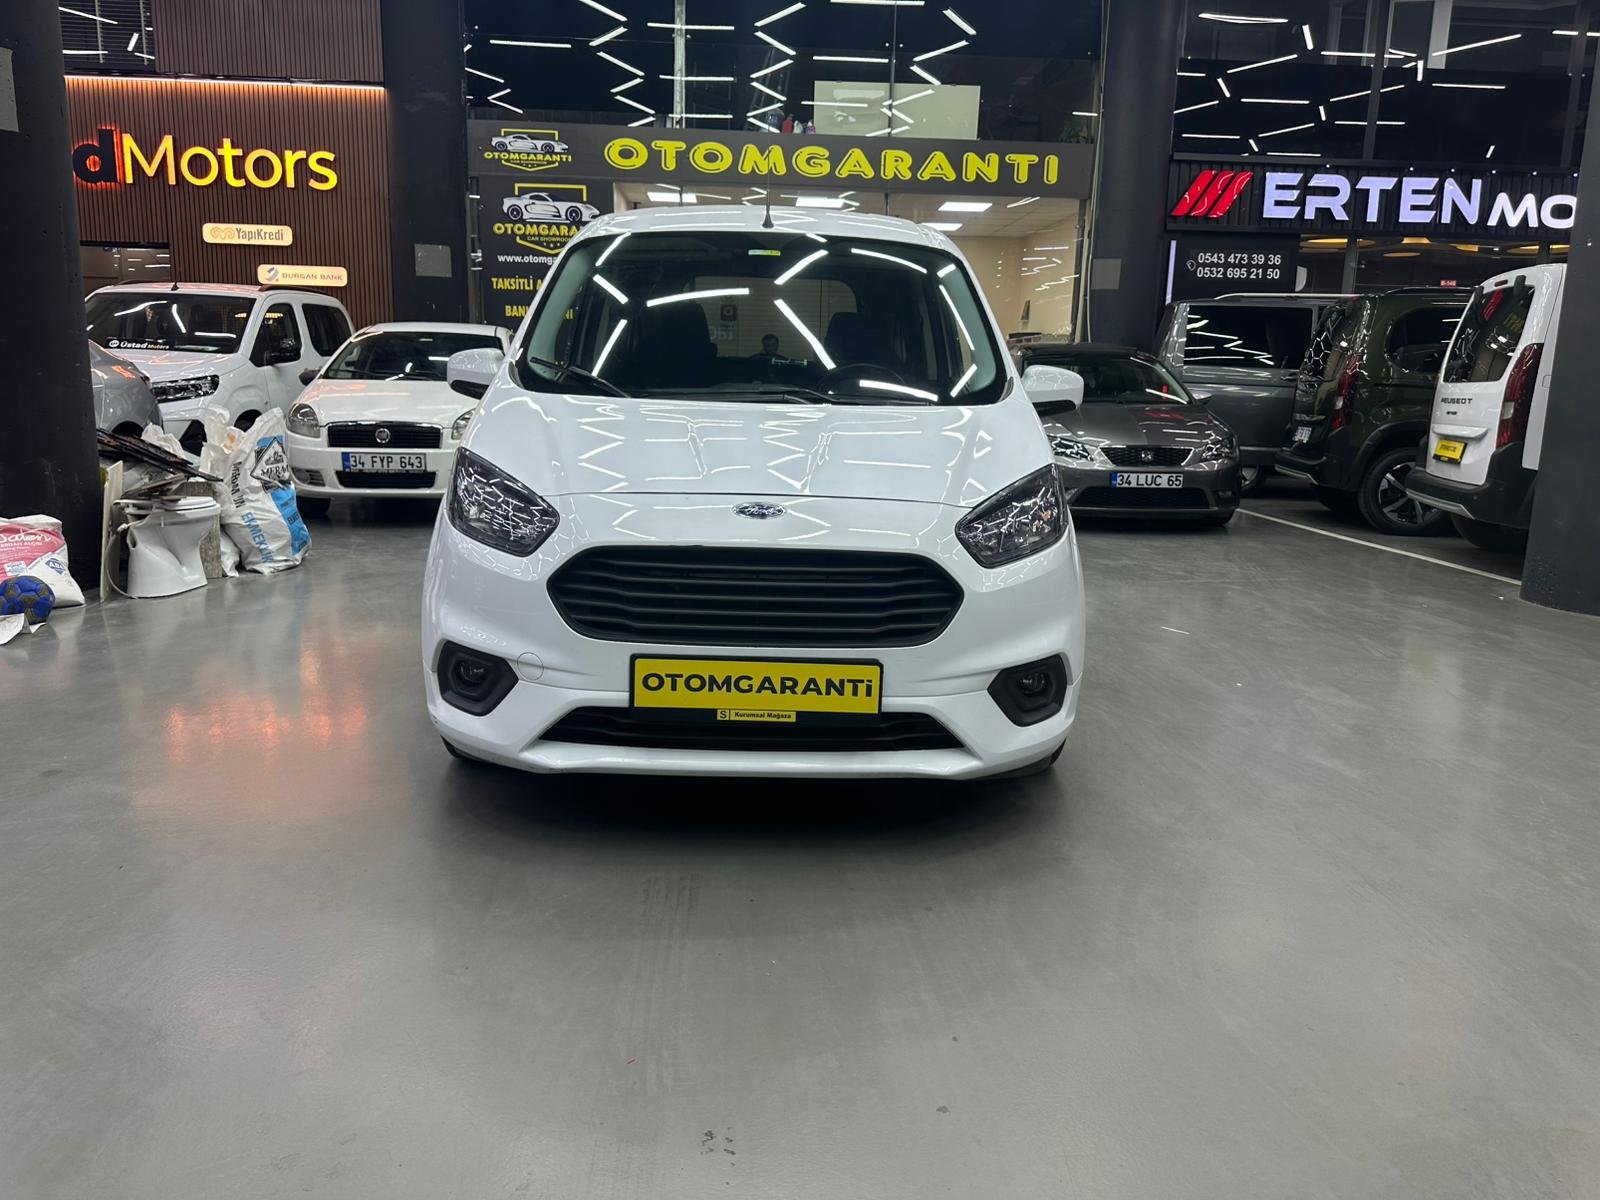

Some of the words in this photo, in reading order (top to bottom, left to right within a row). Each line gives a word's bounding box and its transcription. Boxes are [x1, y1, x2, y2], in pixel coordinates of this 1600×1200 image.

[484, 151, 572, 162] OTOMGARANTI
[604, 137, 1059, 184] OTOMGARANTI
[1263, 172, 1482, 225] ERTEN
[1486, 192, 1577, 229] MO
[493, 222, 579, 236] OTOMGARA
[497, 254, 559, 266] www.otomga
[1198, 253, 1225, 264] 0543
[1228, 253, 1248, 264] 473
[1251, 254, 1265, 265] 39
[1268, 254, 1281, 265] 36
[1197, 267, 1223, 278] 0532
[1226, 268, 1247, 279] 695
[1250, 268, 1262, 279] 21
[1266, 269, 1280, 279] 50
[491, 275, 533, 290] TAKSİTLİ
[120, 340, 147, 349] Üstad
[1441, 397, 1473, 405] PEUGEOT
[351, 455, 365, 468] 34
[371, 455, 393, 468] FYP
[400, 456, 423, 469] 643
[1117, 474, 1132, 486] 34
[1136, 474, 1162, 487] LUC
[1167, 475, 1182, 487] 65
[719, 710, 727, 720] S
[734, 711, 766, 719] Kurumsal
[767, 711, 792, 720] Mağaza
